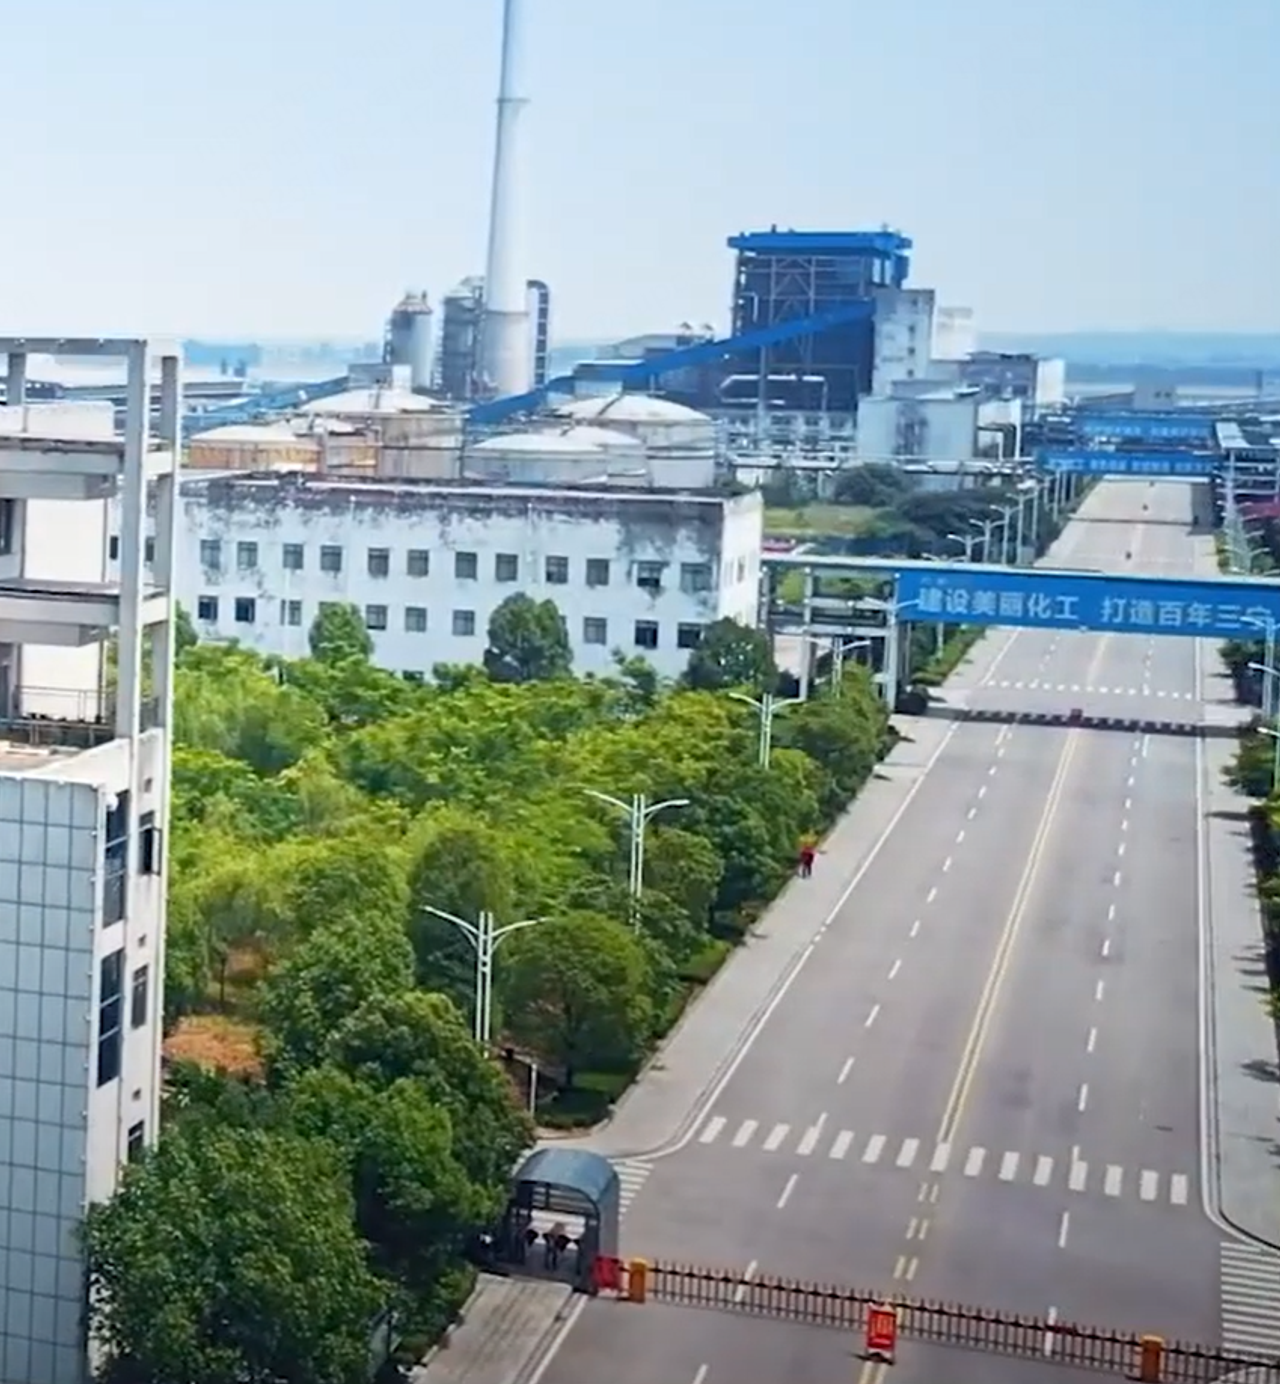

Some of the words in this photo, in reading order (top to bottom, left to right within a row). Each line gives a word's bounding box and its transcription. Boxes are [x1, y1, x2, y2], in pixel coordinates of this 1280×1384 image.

[918, 587, 1080, 620] 建设美丽化工
